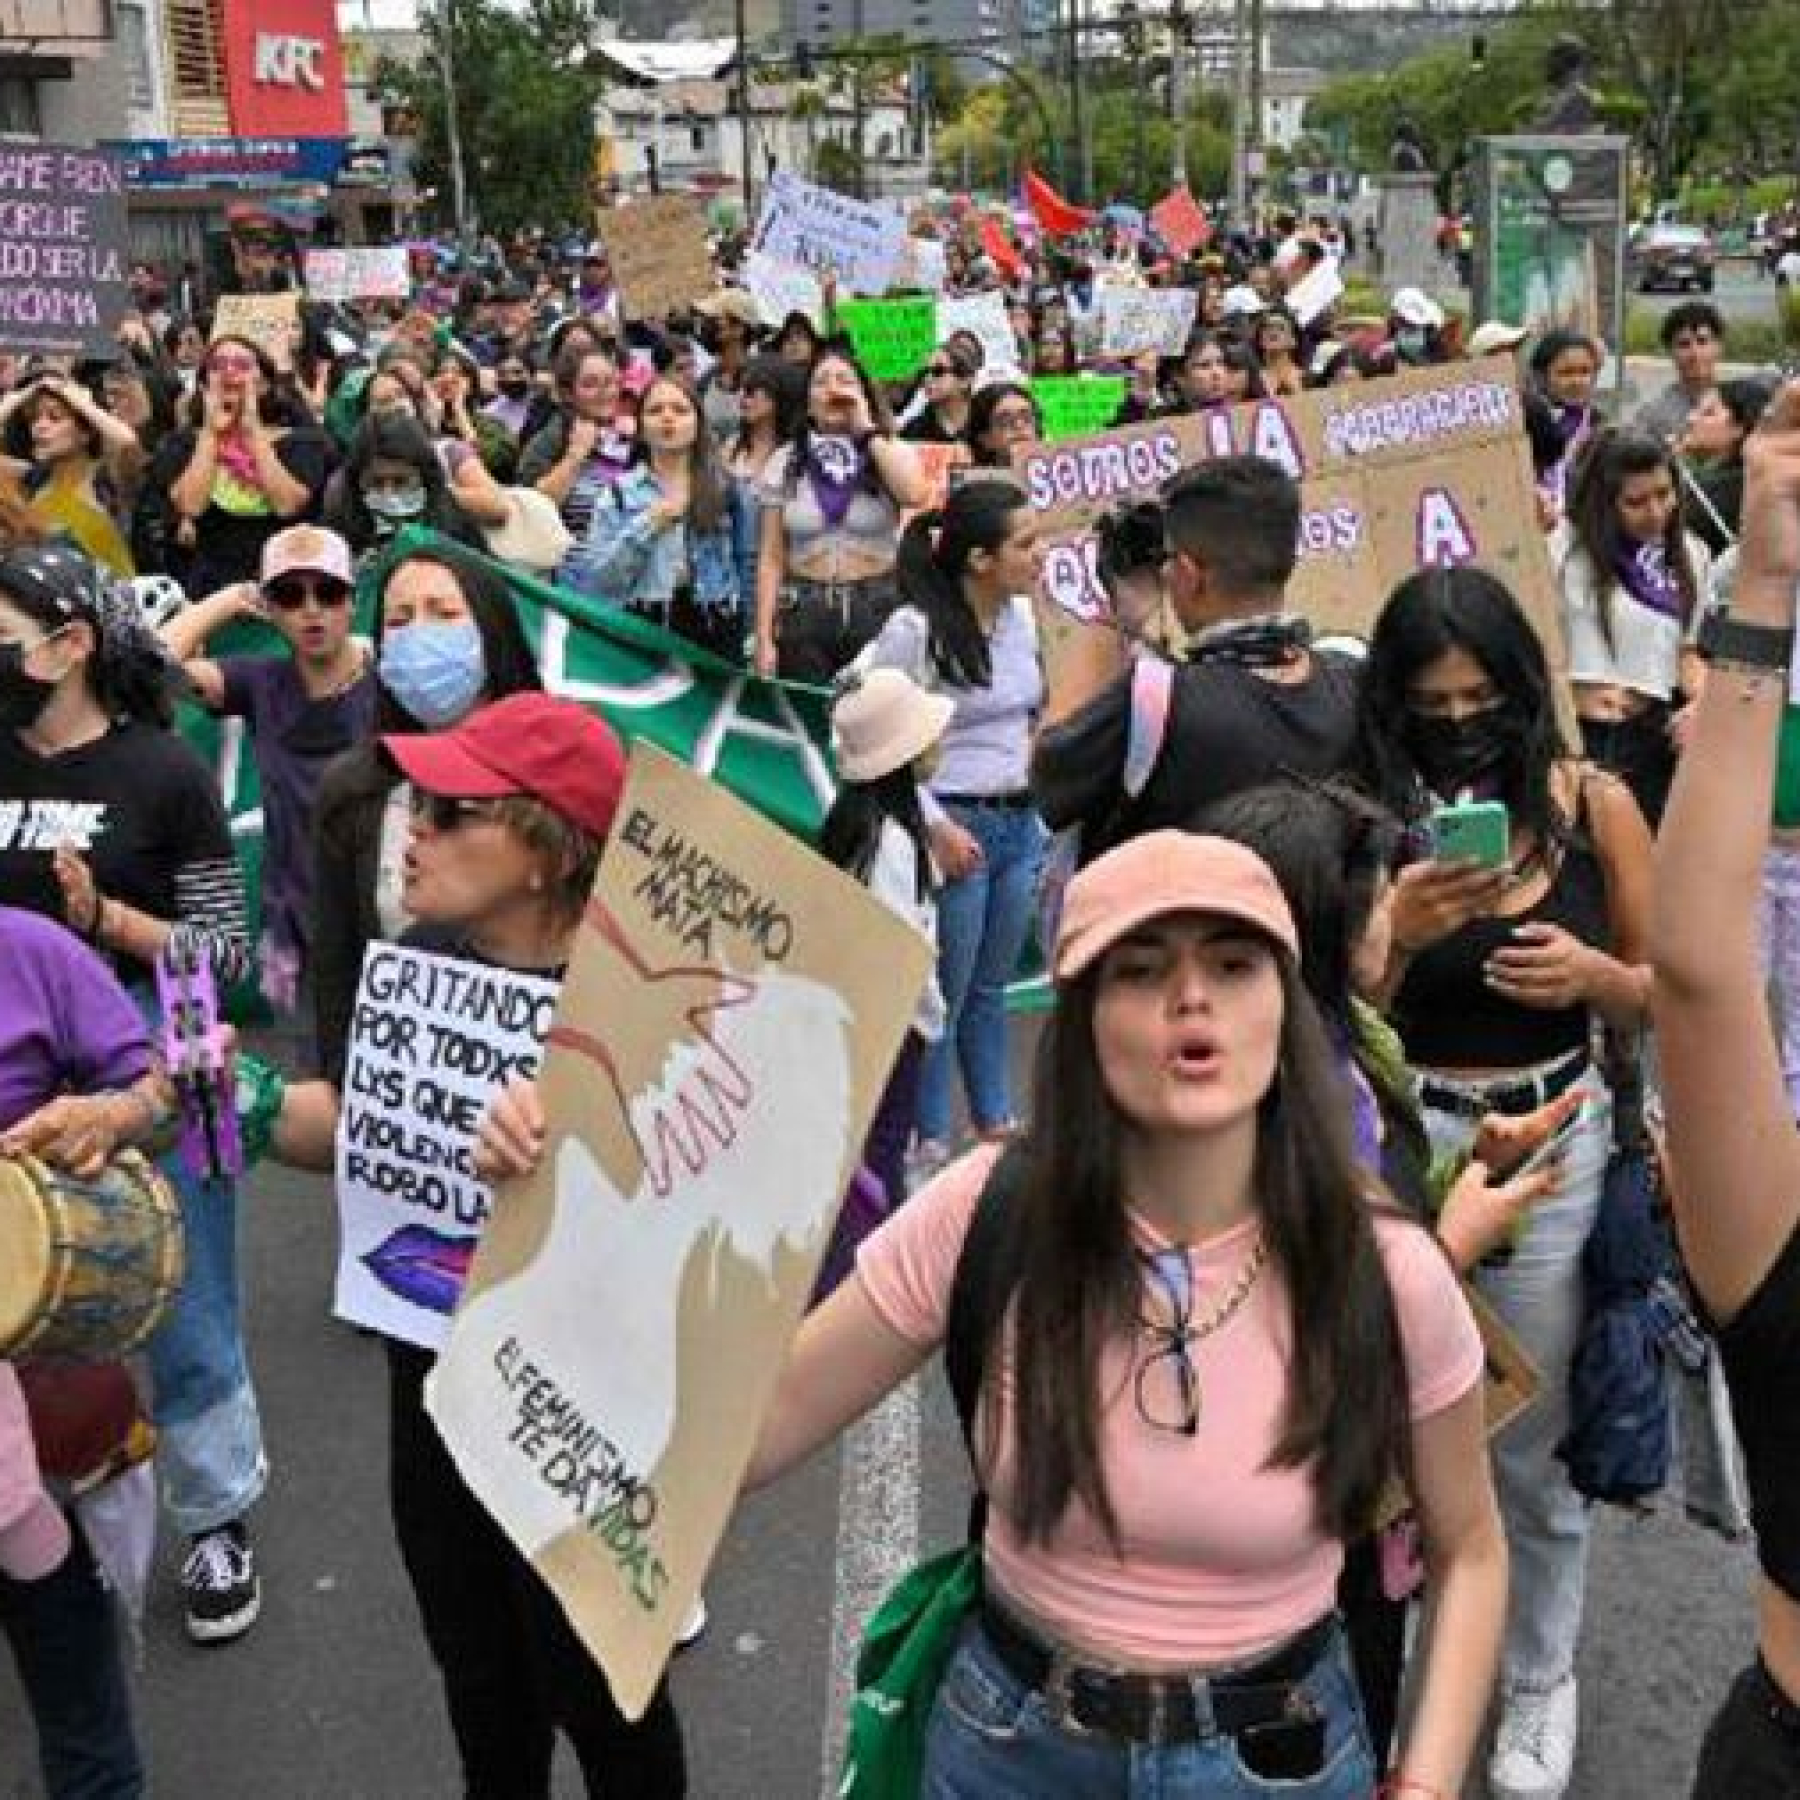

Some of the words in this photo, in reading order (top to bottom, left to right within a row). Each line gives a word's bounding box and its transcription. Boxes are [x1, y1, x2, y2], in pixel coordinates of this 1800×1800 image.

[1025, 432, 1181, 510] SOMOS
[620, 807, 658, 858] EL
[652, 830, 794, 961] MACHISMO
[633, 868, 713, 960] MATA
[355, 1003, 417, 1067] POR
[413, 1080, 485, 1133] QUE
[514, 1362, 657, 1531] FEMINISMO
[541, 1448, 589, 1515] DA
